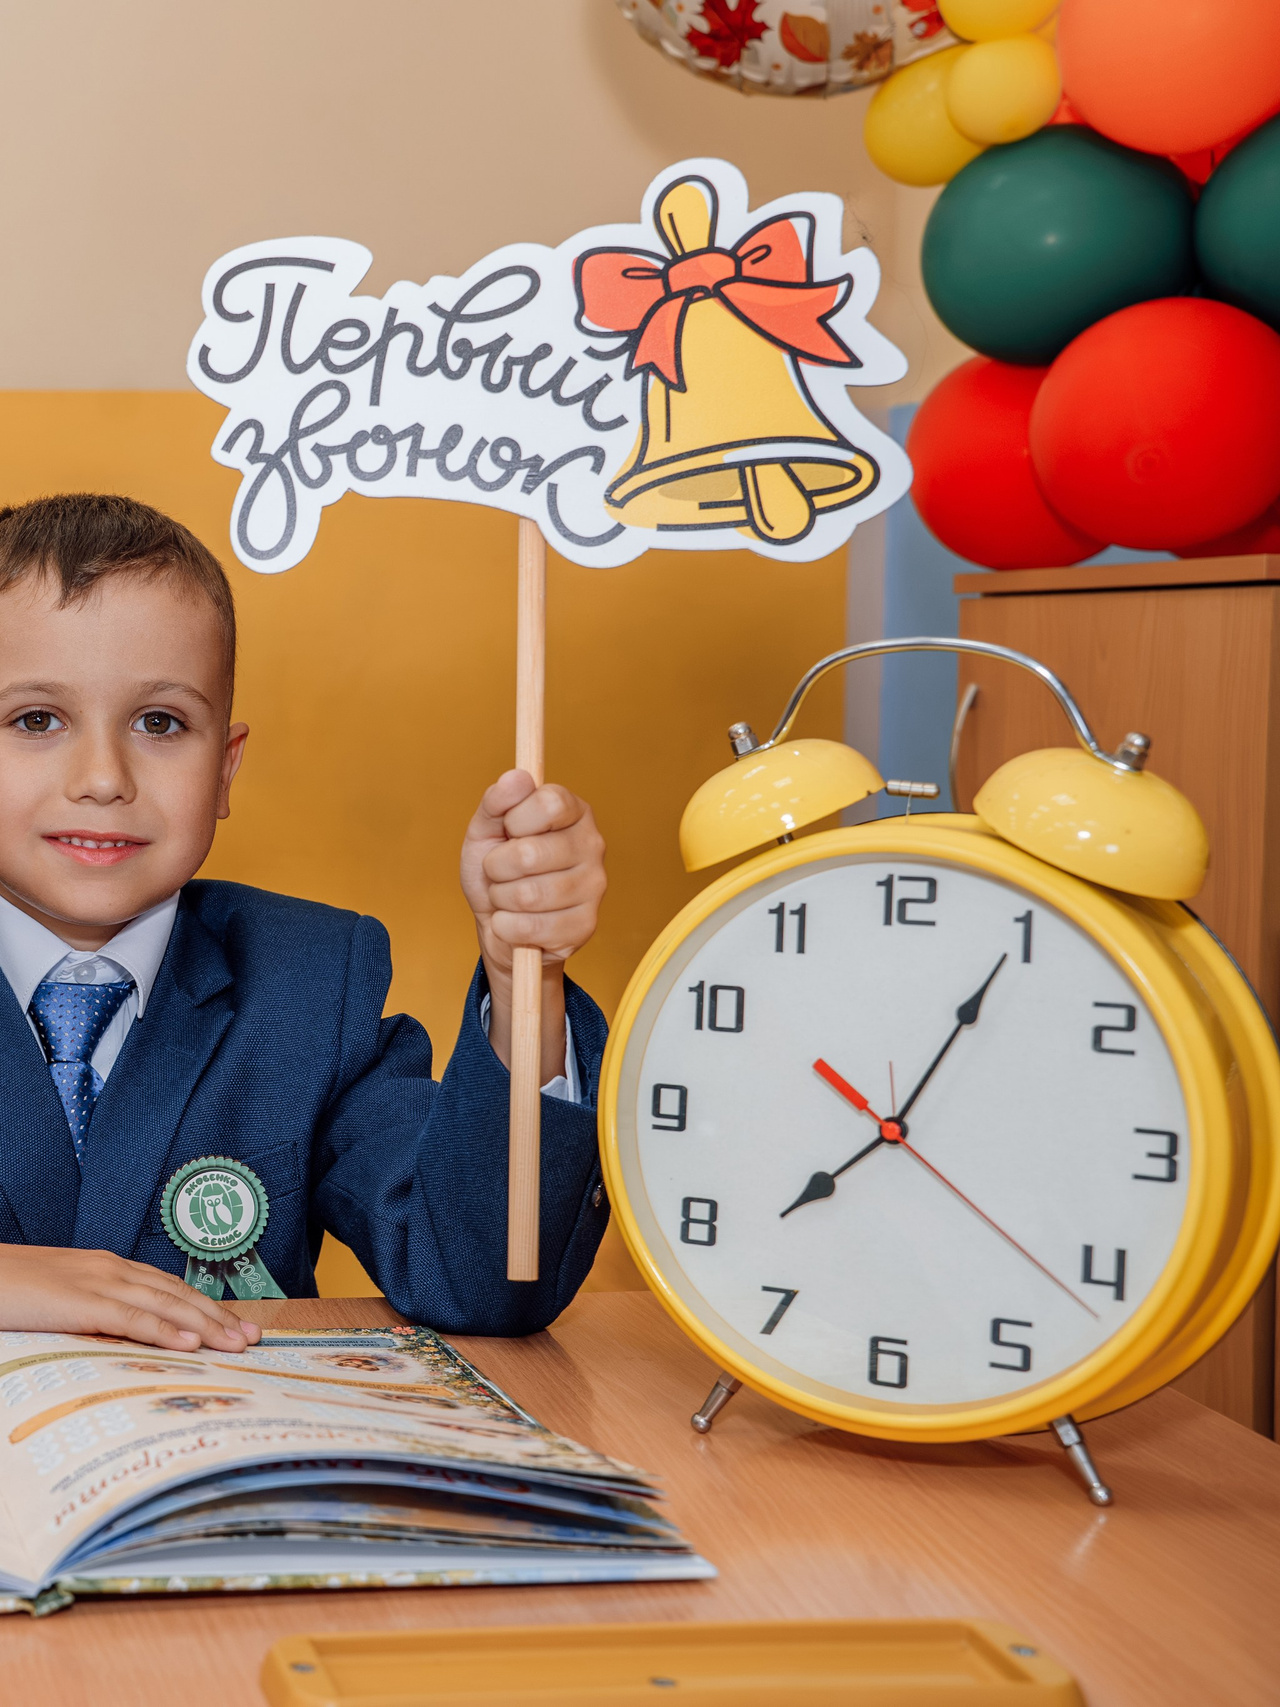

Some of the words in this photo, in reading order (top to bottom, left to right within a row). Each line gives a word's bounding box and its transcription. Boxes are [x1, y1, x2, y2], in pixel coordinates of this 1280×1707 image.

[198, 256, 632, 432] Первый
[221, 379, 627, 561] звонок
[876, 873, 938, 927] 12
[767, 901, 807, 954] 11
[1013, 909, 1034, 964] 1
[687, 980, 745, 1033] 10
[1091, 1001, 1137, 1056] 2
[651, 1082, 688, 1132] 9
[1131, 1126, 1179, 1183] 3
[184, 1173, 239, 1197] ЯКОВЕНКО
[198, 1229, 242, 1246] ДЕНИС
[680, 1195, 718, 1247] 8
[233, 1256, 267, 1294] 2026
[1080, 1244, 1127, 1302] 4
[759, 1284, 800, 1335] 7
[867, 1334, 909, 1389] 6
[988, 1316, 1034, 1373] 5
